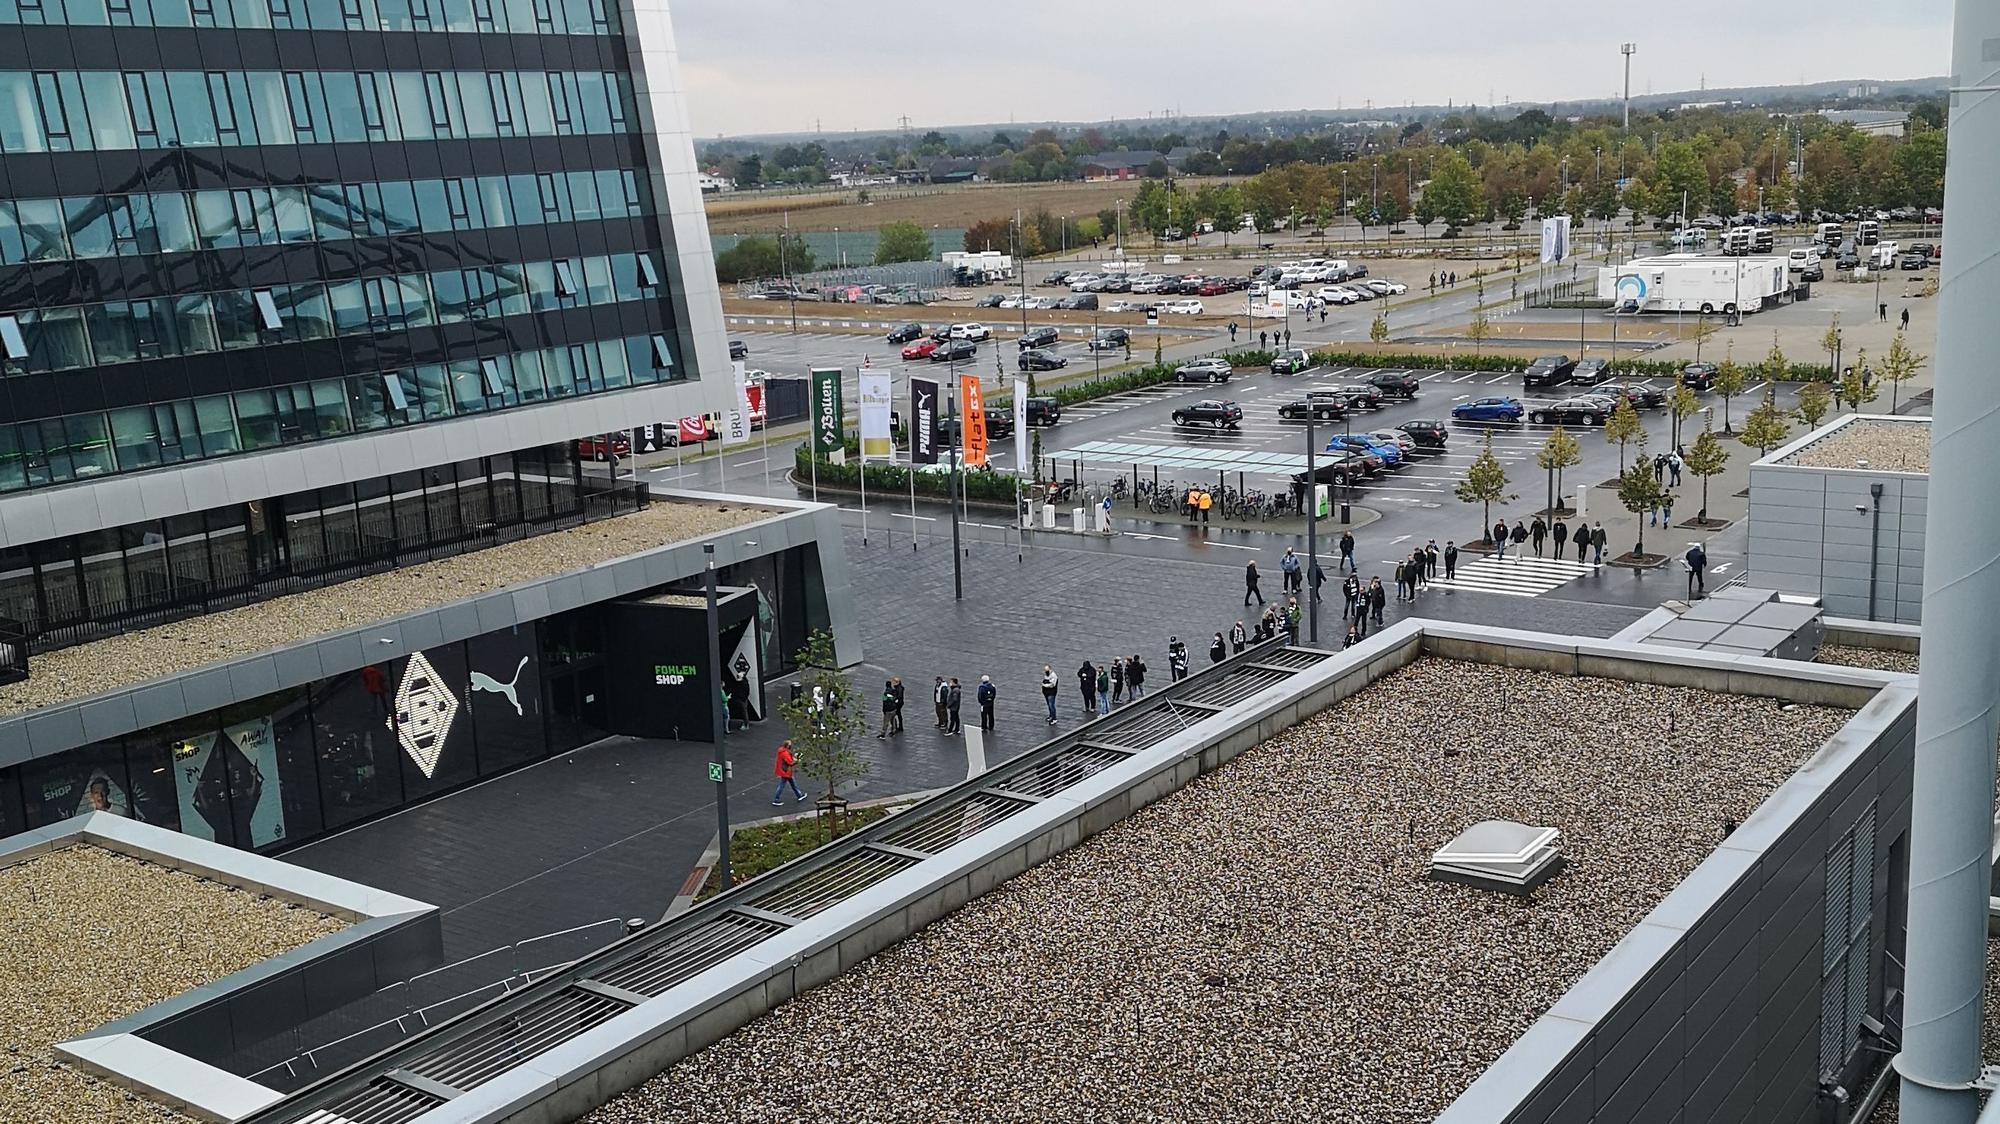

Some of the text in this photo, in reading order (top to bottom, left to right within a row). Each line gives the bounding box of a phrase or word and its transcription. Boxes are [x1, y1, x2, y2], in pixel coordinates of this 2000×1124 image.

[918, 409, 931, 455] PUMA
[654, 665, 697, 676] FOHLEN
[656, 675, 685, 685] SHOP
[175, 747, 200, 762] SHOP
[44, 785, 72, 801] SHOP
